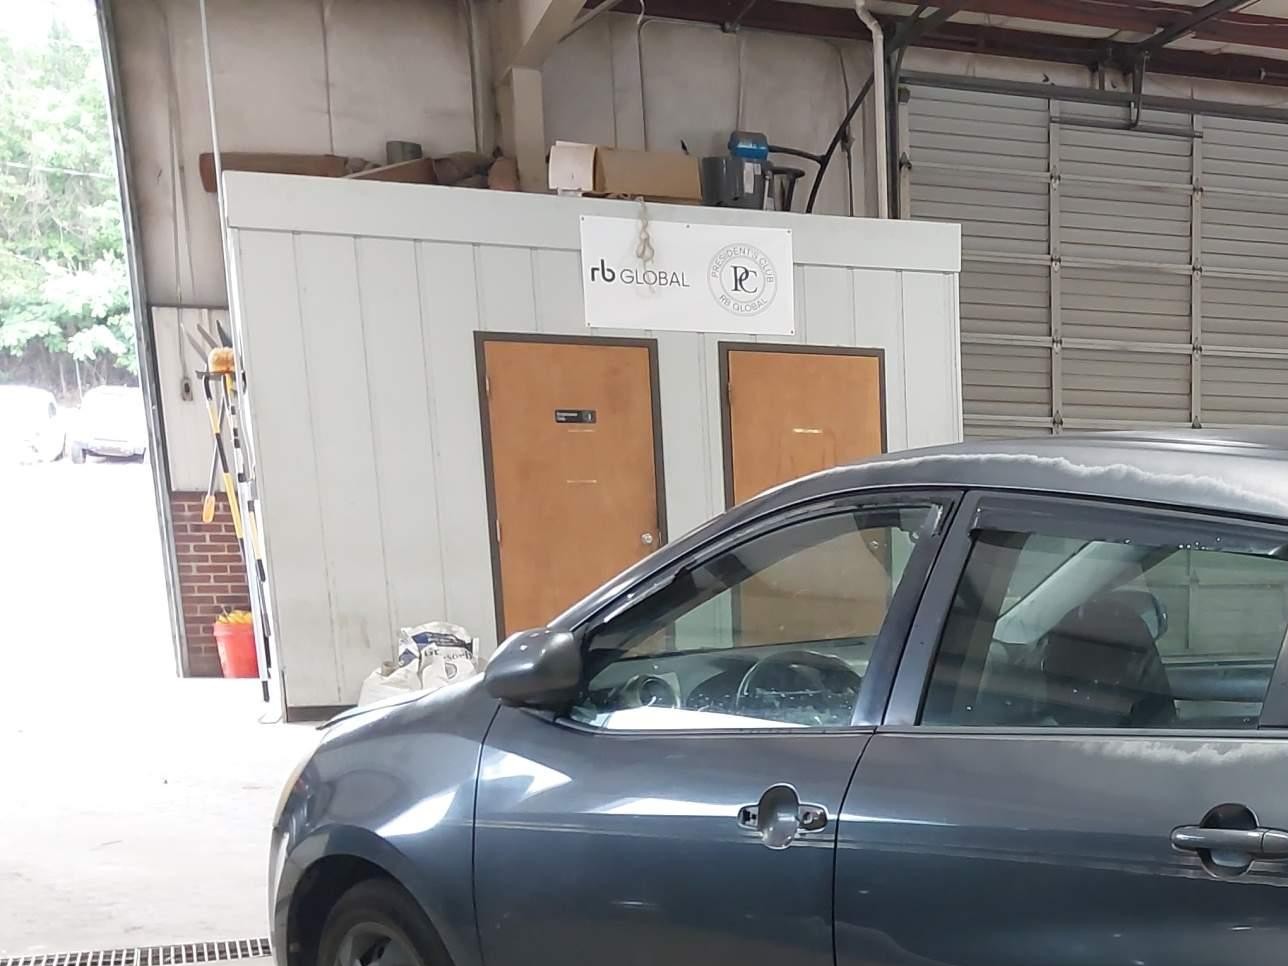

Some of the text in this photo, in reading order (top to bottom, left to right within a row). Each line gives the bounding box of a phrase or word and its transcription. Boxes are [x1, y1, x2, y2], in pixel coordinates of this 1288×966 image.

[590, 258, 690, 288] rb GLOBAL
[759, 257, 775, 283] CLUB
[719, 294, 768, 312] RB GLOBAL
